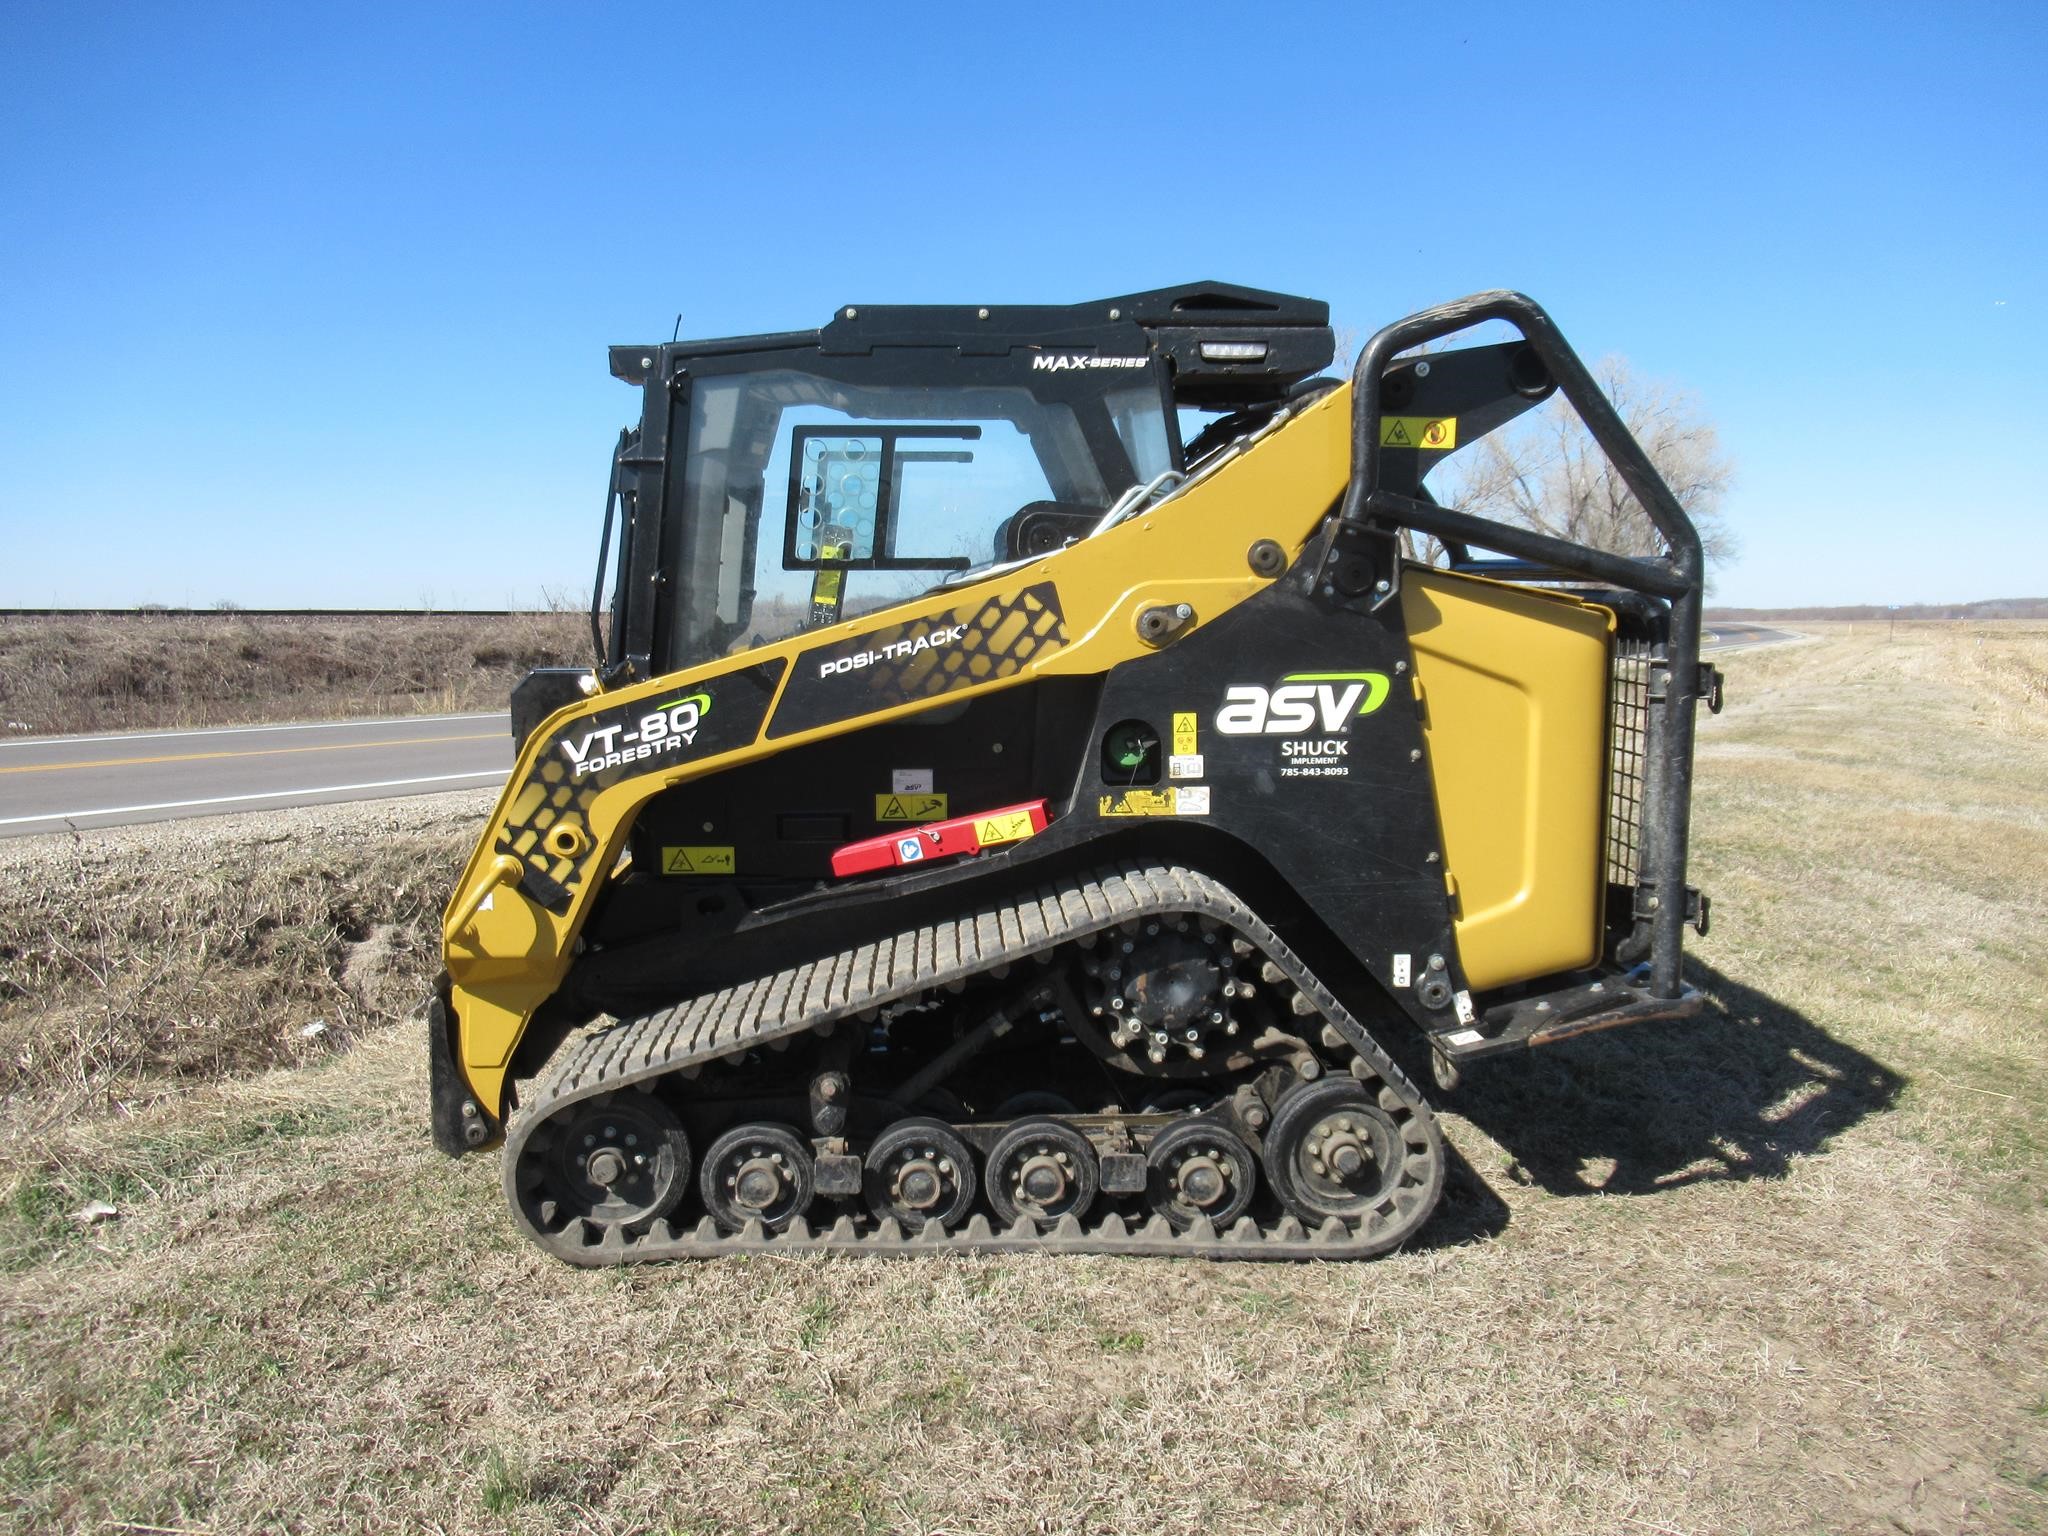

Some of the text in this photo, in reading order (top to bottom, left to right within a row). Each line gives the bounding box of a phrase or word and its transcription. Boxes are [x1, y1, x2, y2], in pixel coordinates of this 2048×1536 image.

[1033, 355, 1149, 372] MAX-SERIES
[820, 625, 963, 679] POSI-TRACK
[561, 703, 699, 763] VT-80
[576, 729, 698, 777] FORESTRY
[1281, 740, 1349, 756] SHUCK
[1291, 757, 1339, 765] IMPLEMENT
[1281, 767, 1349, 776] 785-843-8093
